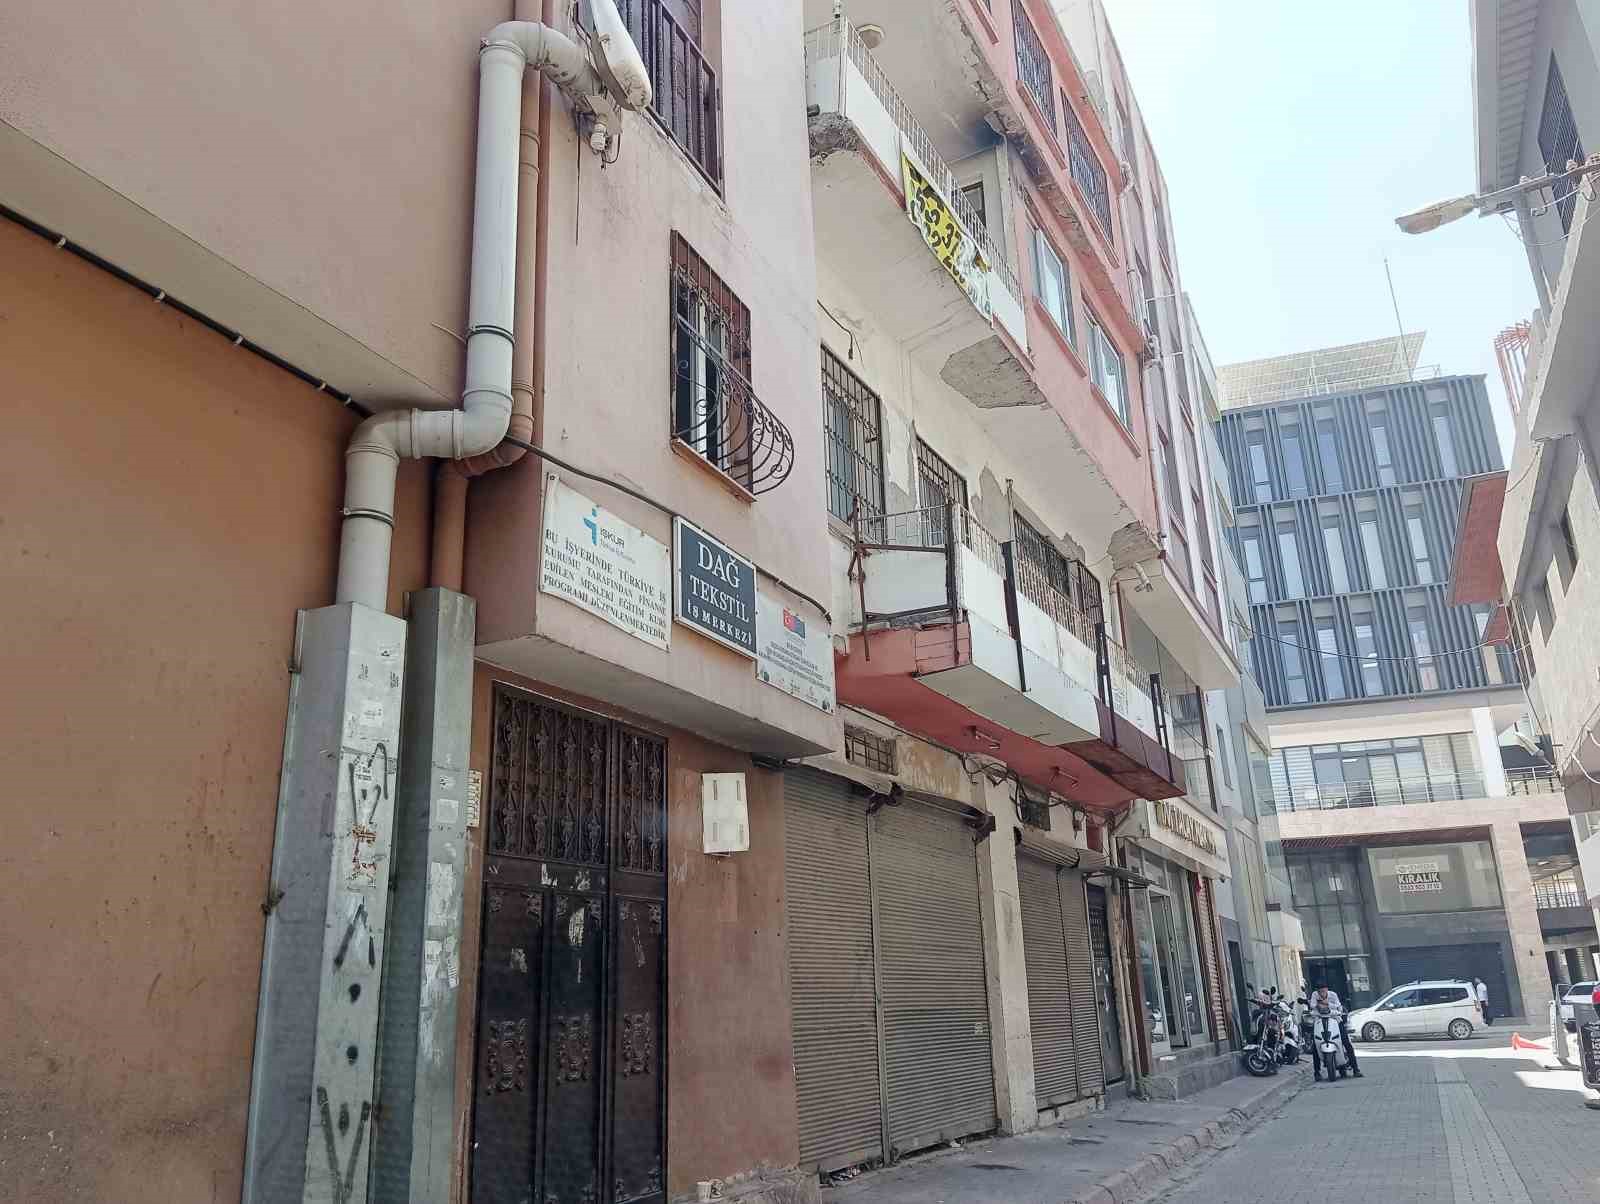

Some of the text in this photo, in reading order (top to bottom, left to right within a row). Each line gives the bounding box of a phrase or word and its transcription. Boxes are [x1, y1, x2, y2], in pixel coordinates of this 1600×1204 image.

[545, 545, 581, 569] KURUMU
[545, 528, 558, 544] BU
[565, 537, 613, 574] İŞYERİNDE
[618, 568, 654, 596] TÜRKİYE
[697, 541, 741, 588] DAĞ
[544, 573, 588, 603] PROGRAMI
[690, 574, 750, 623] TEKSTİL
[702, 609, 752, 645] MERKEZİ
